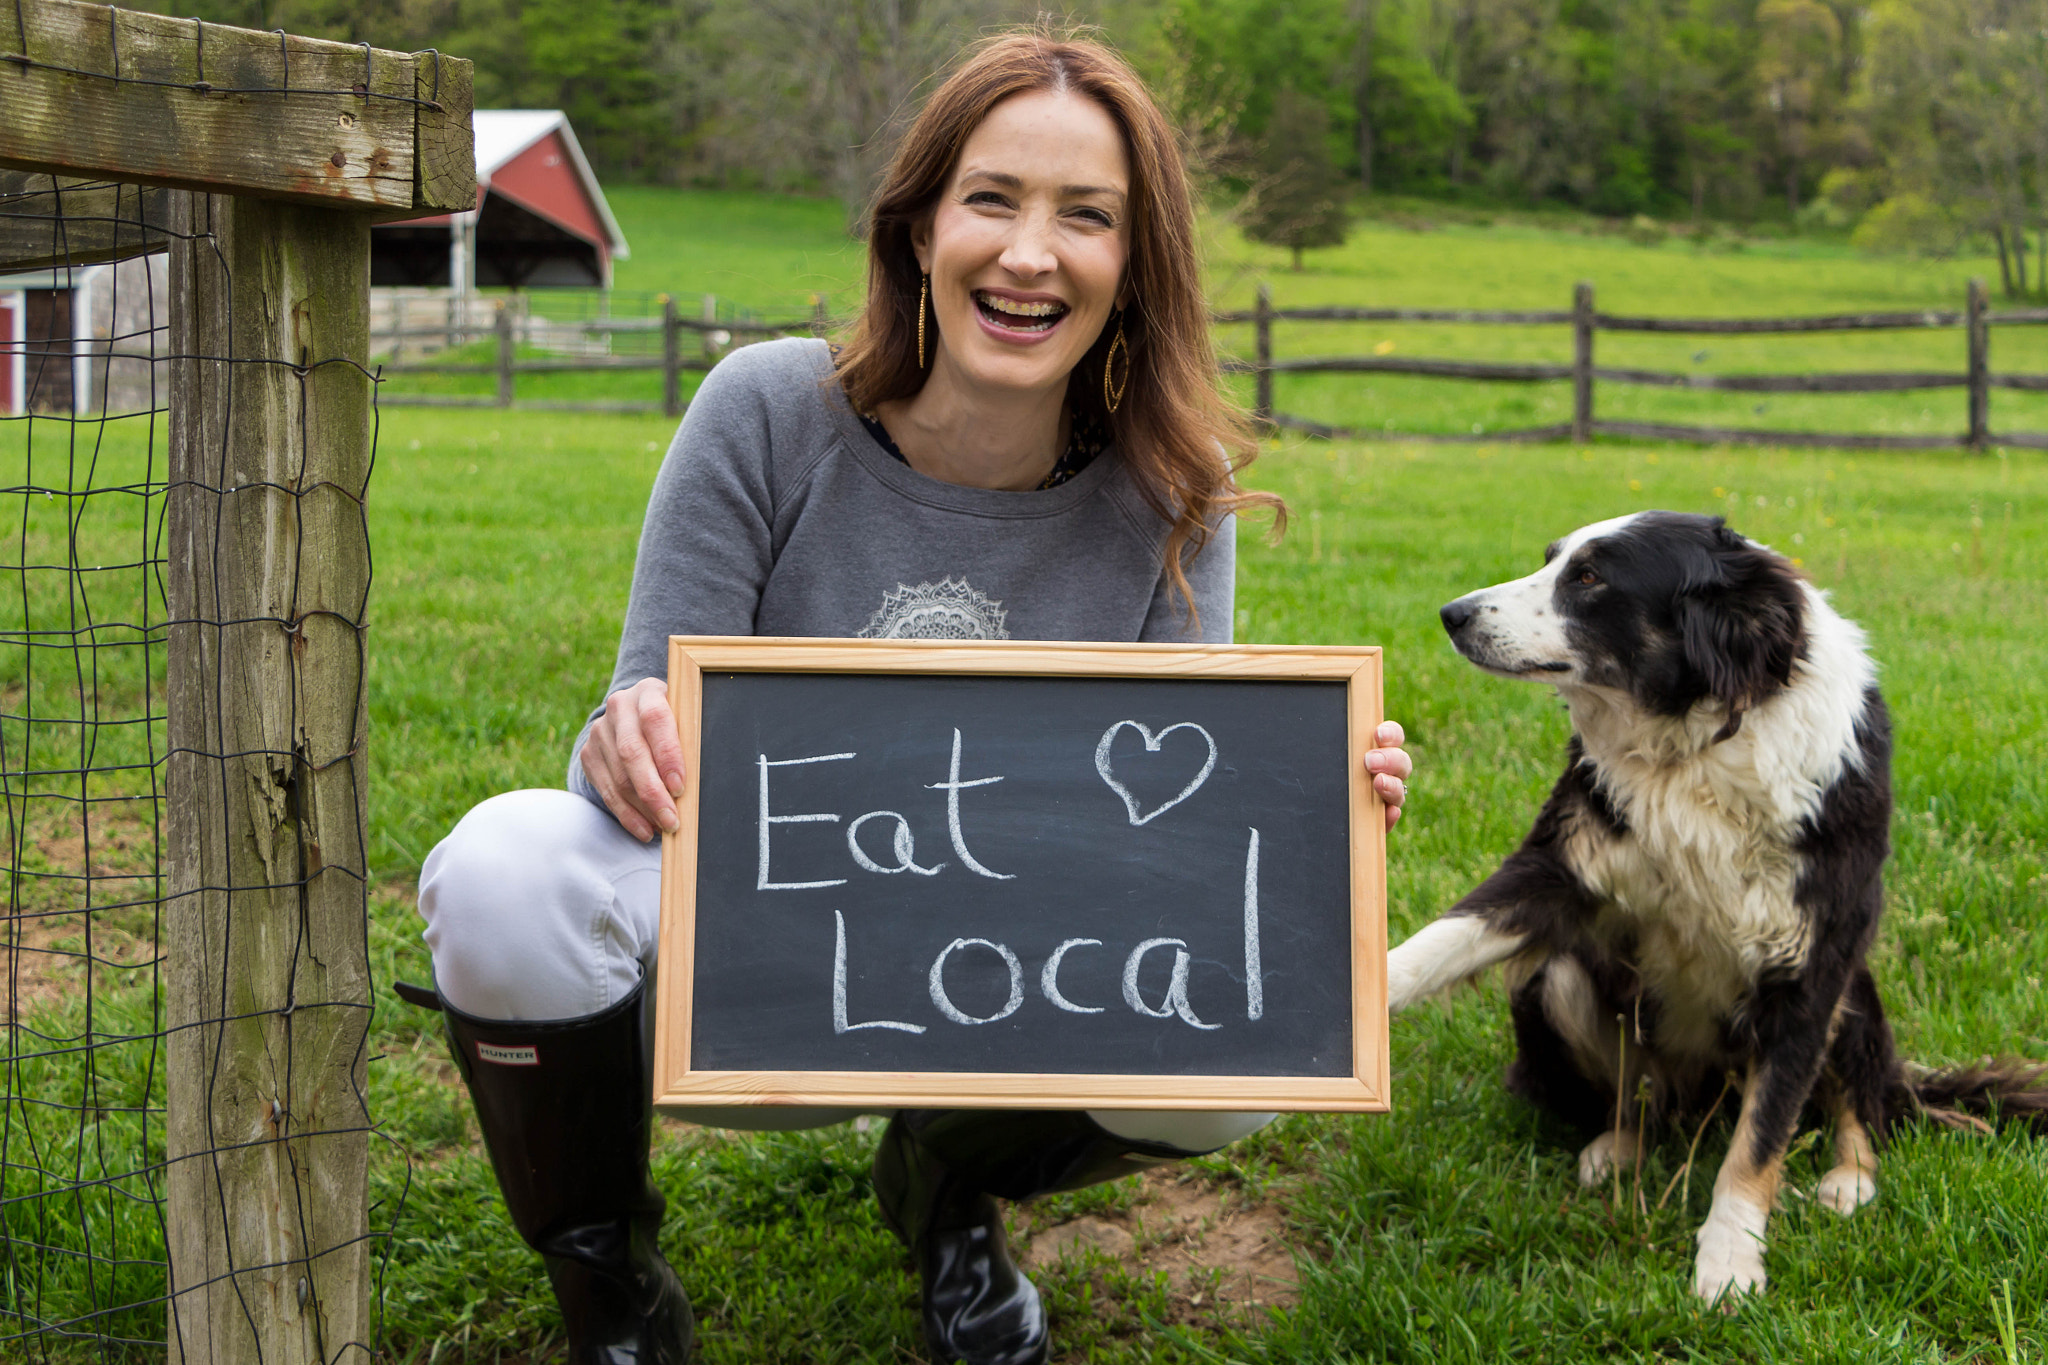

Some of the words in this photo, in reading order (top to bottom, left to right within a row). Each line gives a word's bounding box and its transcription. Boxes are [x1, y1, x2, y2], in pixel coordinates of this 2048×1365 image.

[756, 728, 1016, 891] Eat
[833, 827, 1263, 1034] Local
[480, 1048, 534, 1059] HUNTER
